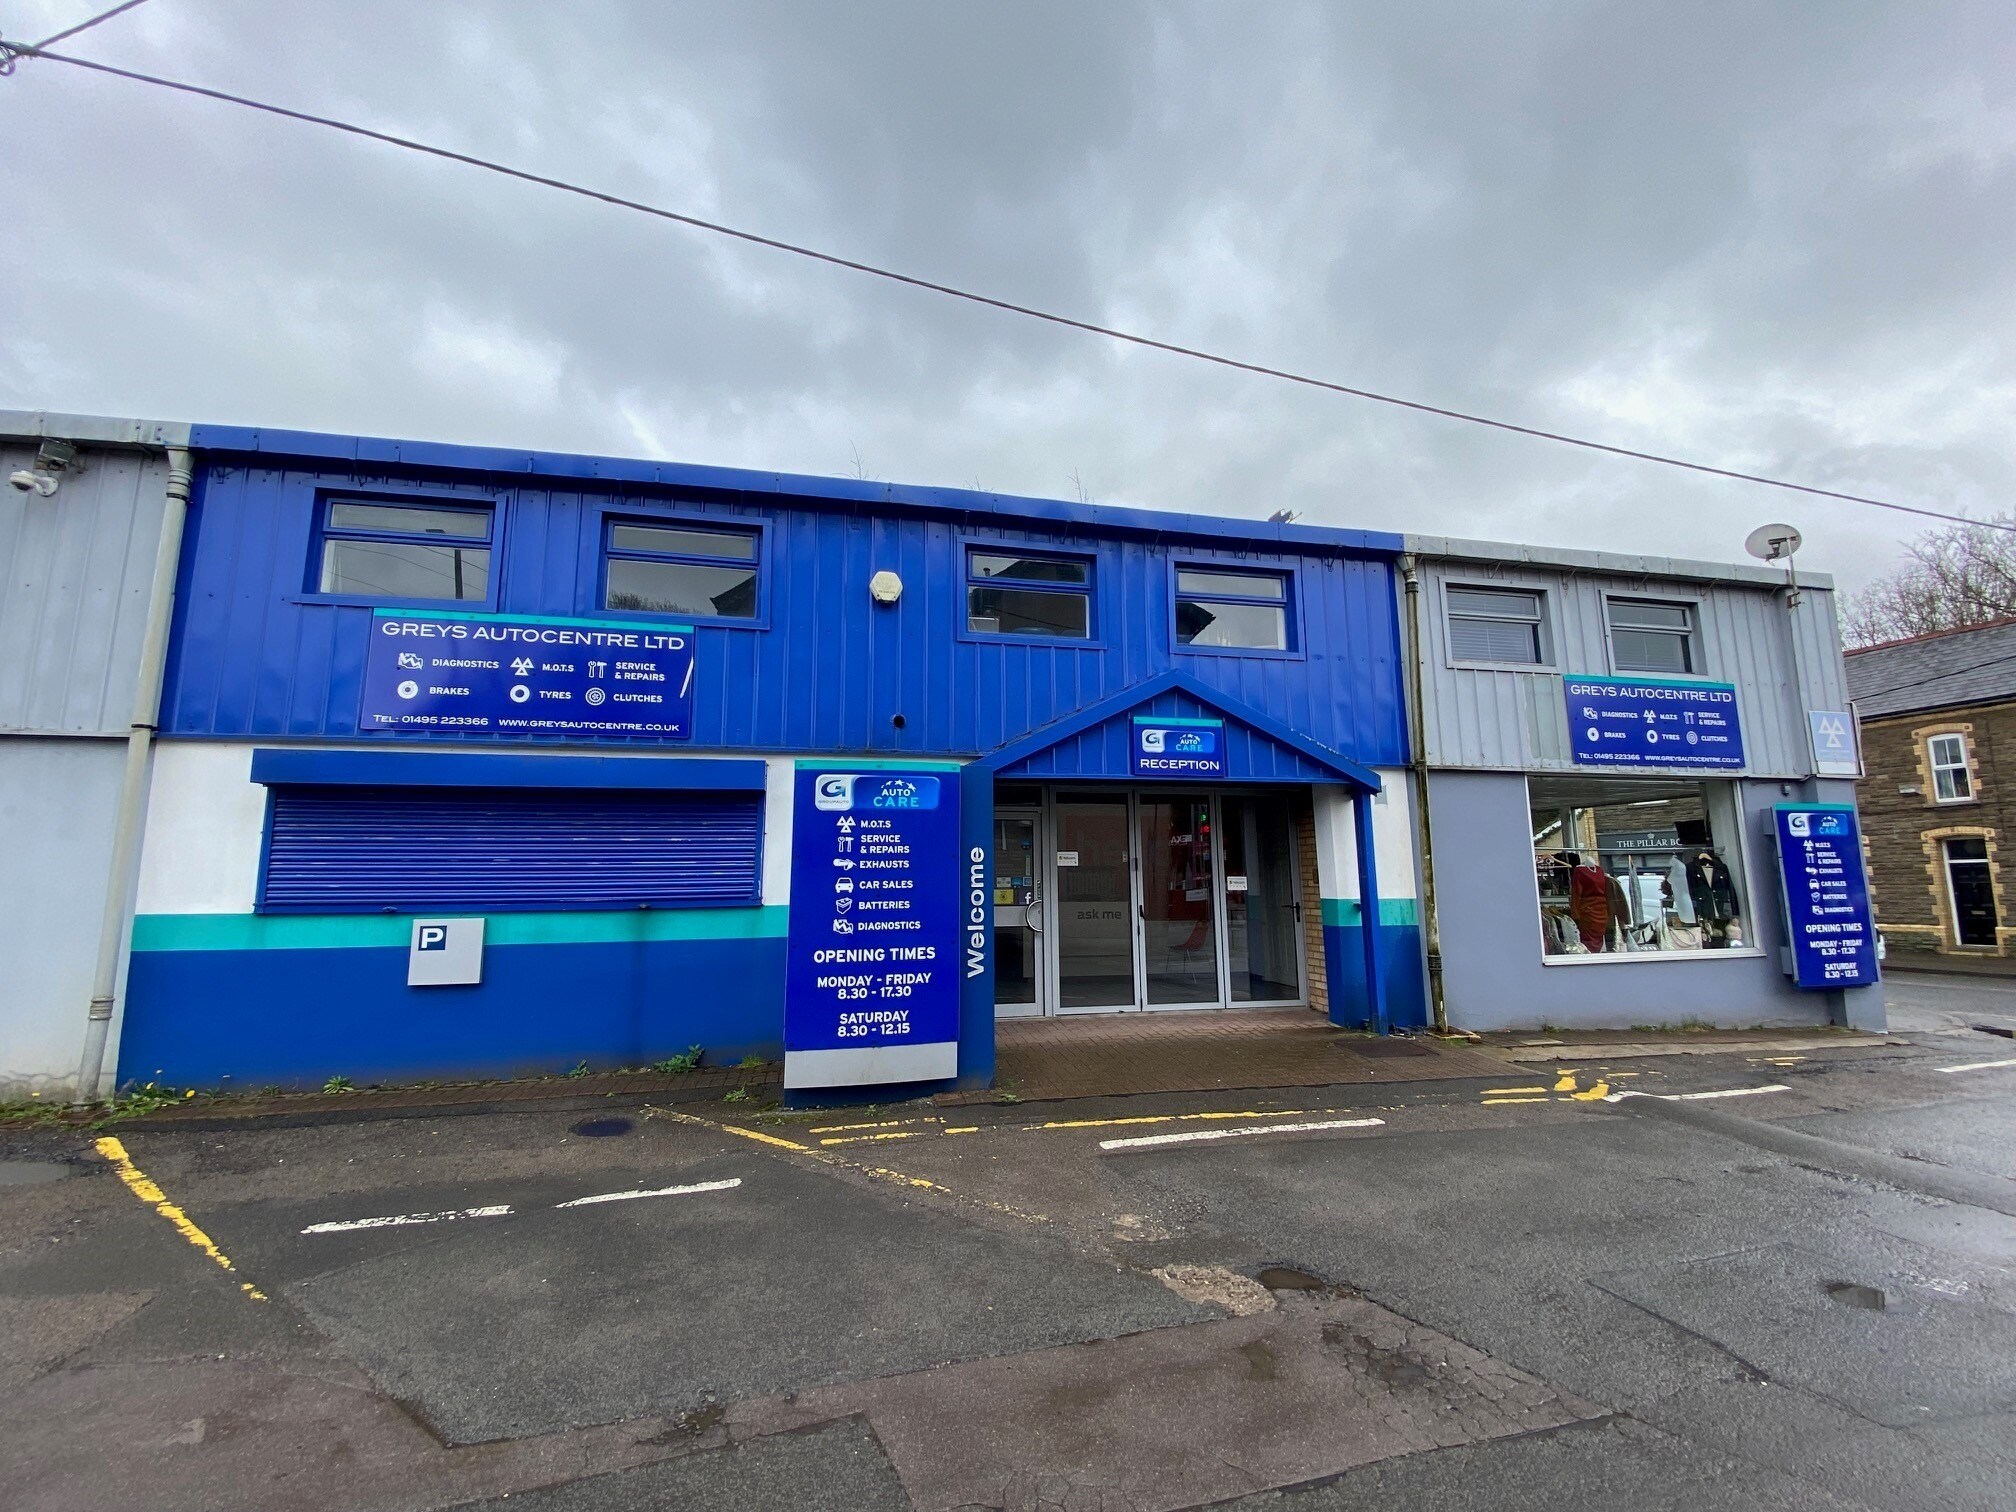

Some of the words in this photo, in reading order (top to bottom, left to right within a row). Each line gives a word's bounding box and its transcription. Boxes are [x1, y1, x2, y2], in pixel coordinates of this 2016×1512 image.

[382, 622, 467, 639] GREYS
[473, 626, 638, 648] AUTOCENTRE
[644, 635, 684, 650] LTD
[432, 658, 499, 669] DIAGNOSTICS
[542, 663, 574, 673] M.O.T.S
[615, 662, 656, 671] SERVICE
[615, 672, 622, 681] &
[623, 672, 665, 682] REPAIRS
[429, 686, 470, 696] BRAKES
[539, 690, 572, 700] TYRES
[1570, 684, 1617, 697] GREYS
[1619, 687, 1708, 702] AUTOCENTRE
[1710, 691, 1732, 702] LTD
[613, 693, 663, 703] CLUTCHES
[1602, 711, 1638, 719] DIAGNOSTICS
[402, 715, 438, 725] 01495
[440, 716, 489, 726] 223366
[1140, 759, 1220, 770] RECEPTION
[881, 788, 911, 796] AUTO
[873, 797, 919, 807] CARE
[860, 820, 892, 828] M.O.T.S
[860, 834, 901, 843] SERVICE
[1637, 838, 1668, 846] PILLAR
[860, 846, 868, 854] &
[869, 846, 910, 854] REPAIRS
[860, 860, 910, 868] EXHAUSTS
[859, 881, 880, 889] CAR
[882, 880, 914, 889] SALES
[858, 900, 910, 910] BATTERIES
[967, 846, 985, 978] Welcome
[1077, 909, 1100, 920] ask
[1102, 910, 1122, 920] me
[858, 921, 922, 931] DIAGNOSTICS
[1806, 924, 1841, 933] OPENING
[1842, 923, 1863, 932] TIMES
[420, 928, 444, 949] P
[813, 948, 886, 964] OPENING
[890, 946, 936, 961] TIMES
[1825, 962, 1857, 970] SATURDAY
[817, 975, 874, 988] MONDAY
[886, 972, 932, 986] FRIDAY
[837, 988, 868, 1000] 8.30
[880, 986, 912, 998] 17.30
[839, 1010, 909, 1024] SATURDAY
[837, 1025, 868, 1038] 8.30
[880, 1022, 910, 1035] 12.15
